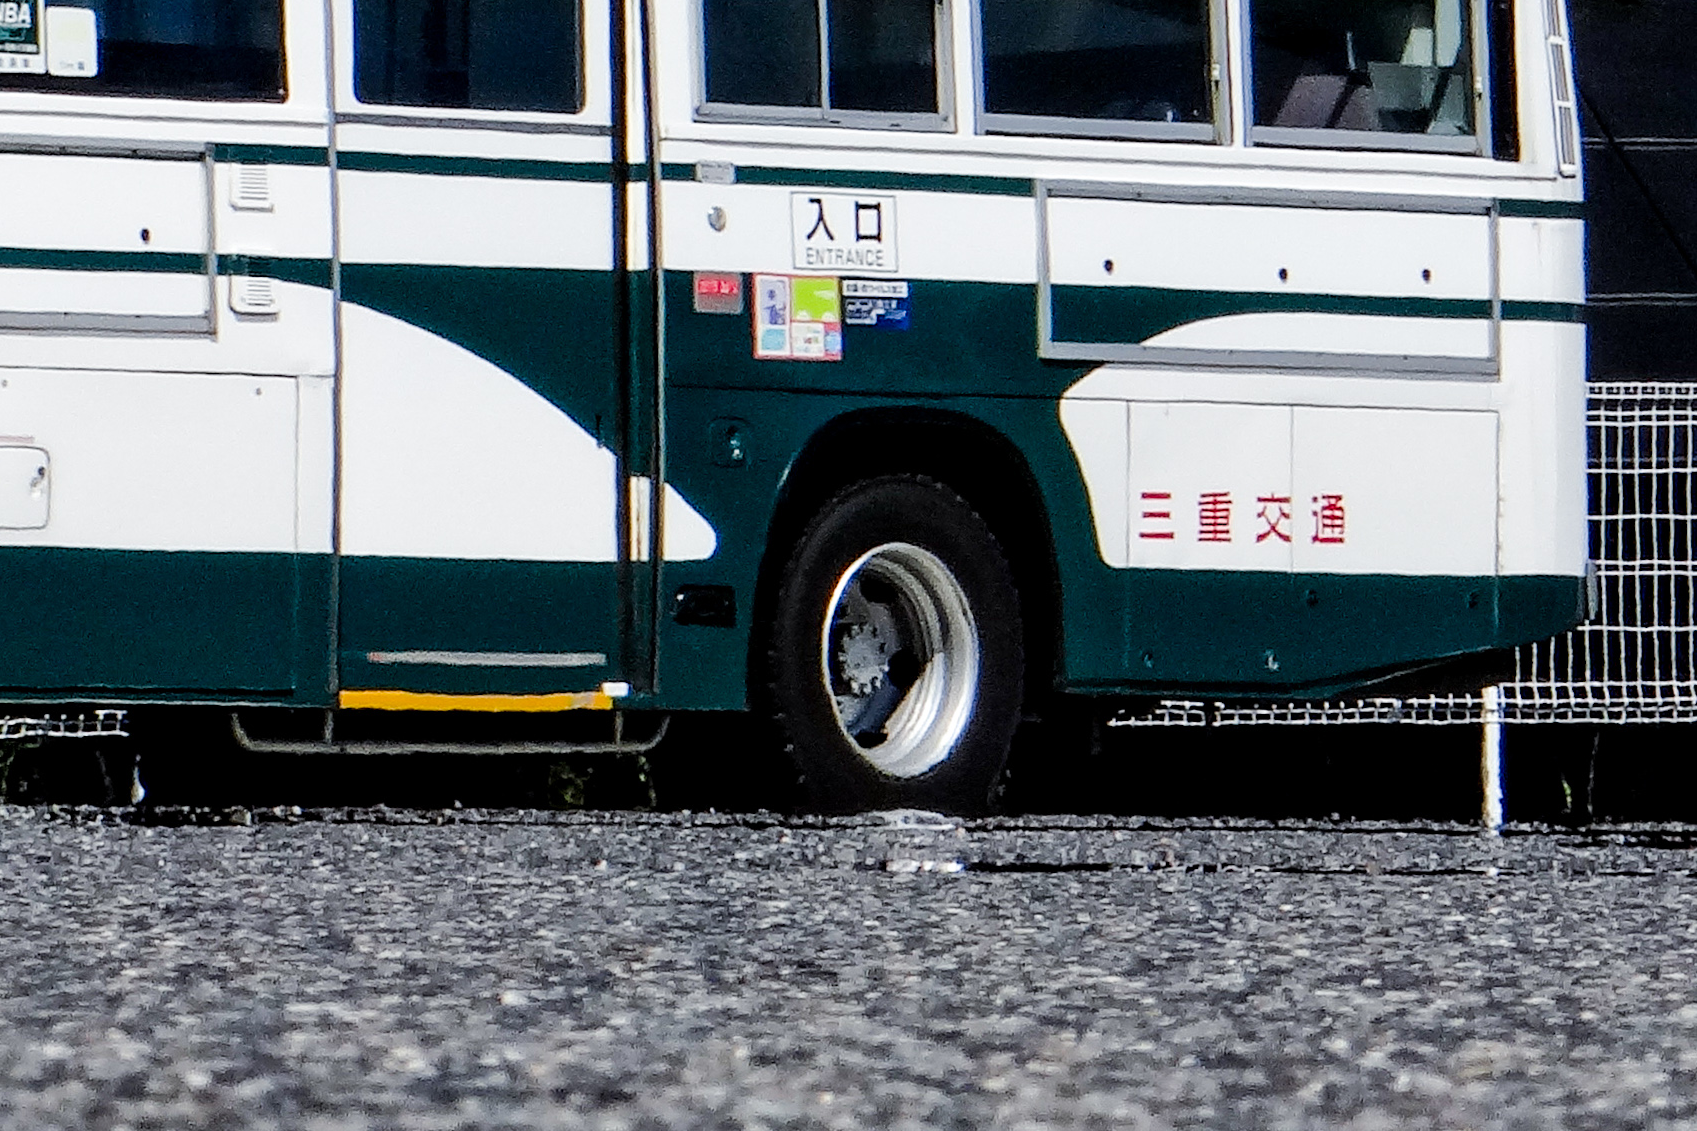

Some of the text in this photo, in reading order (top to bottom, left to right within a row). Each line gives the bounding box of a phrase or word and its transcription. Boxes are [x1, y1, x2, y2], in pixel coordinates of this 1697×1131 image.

[806, 198, 883, 243] 入口
[806, 247, 884, 267] ENTRANCE
[1138, 492, 1345, 544] 三重交通
